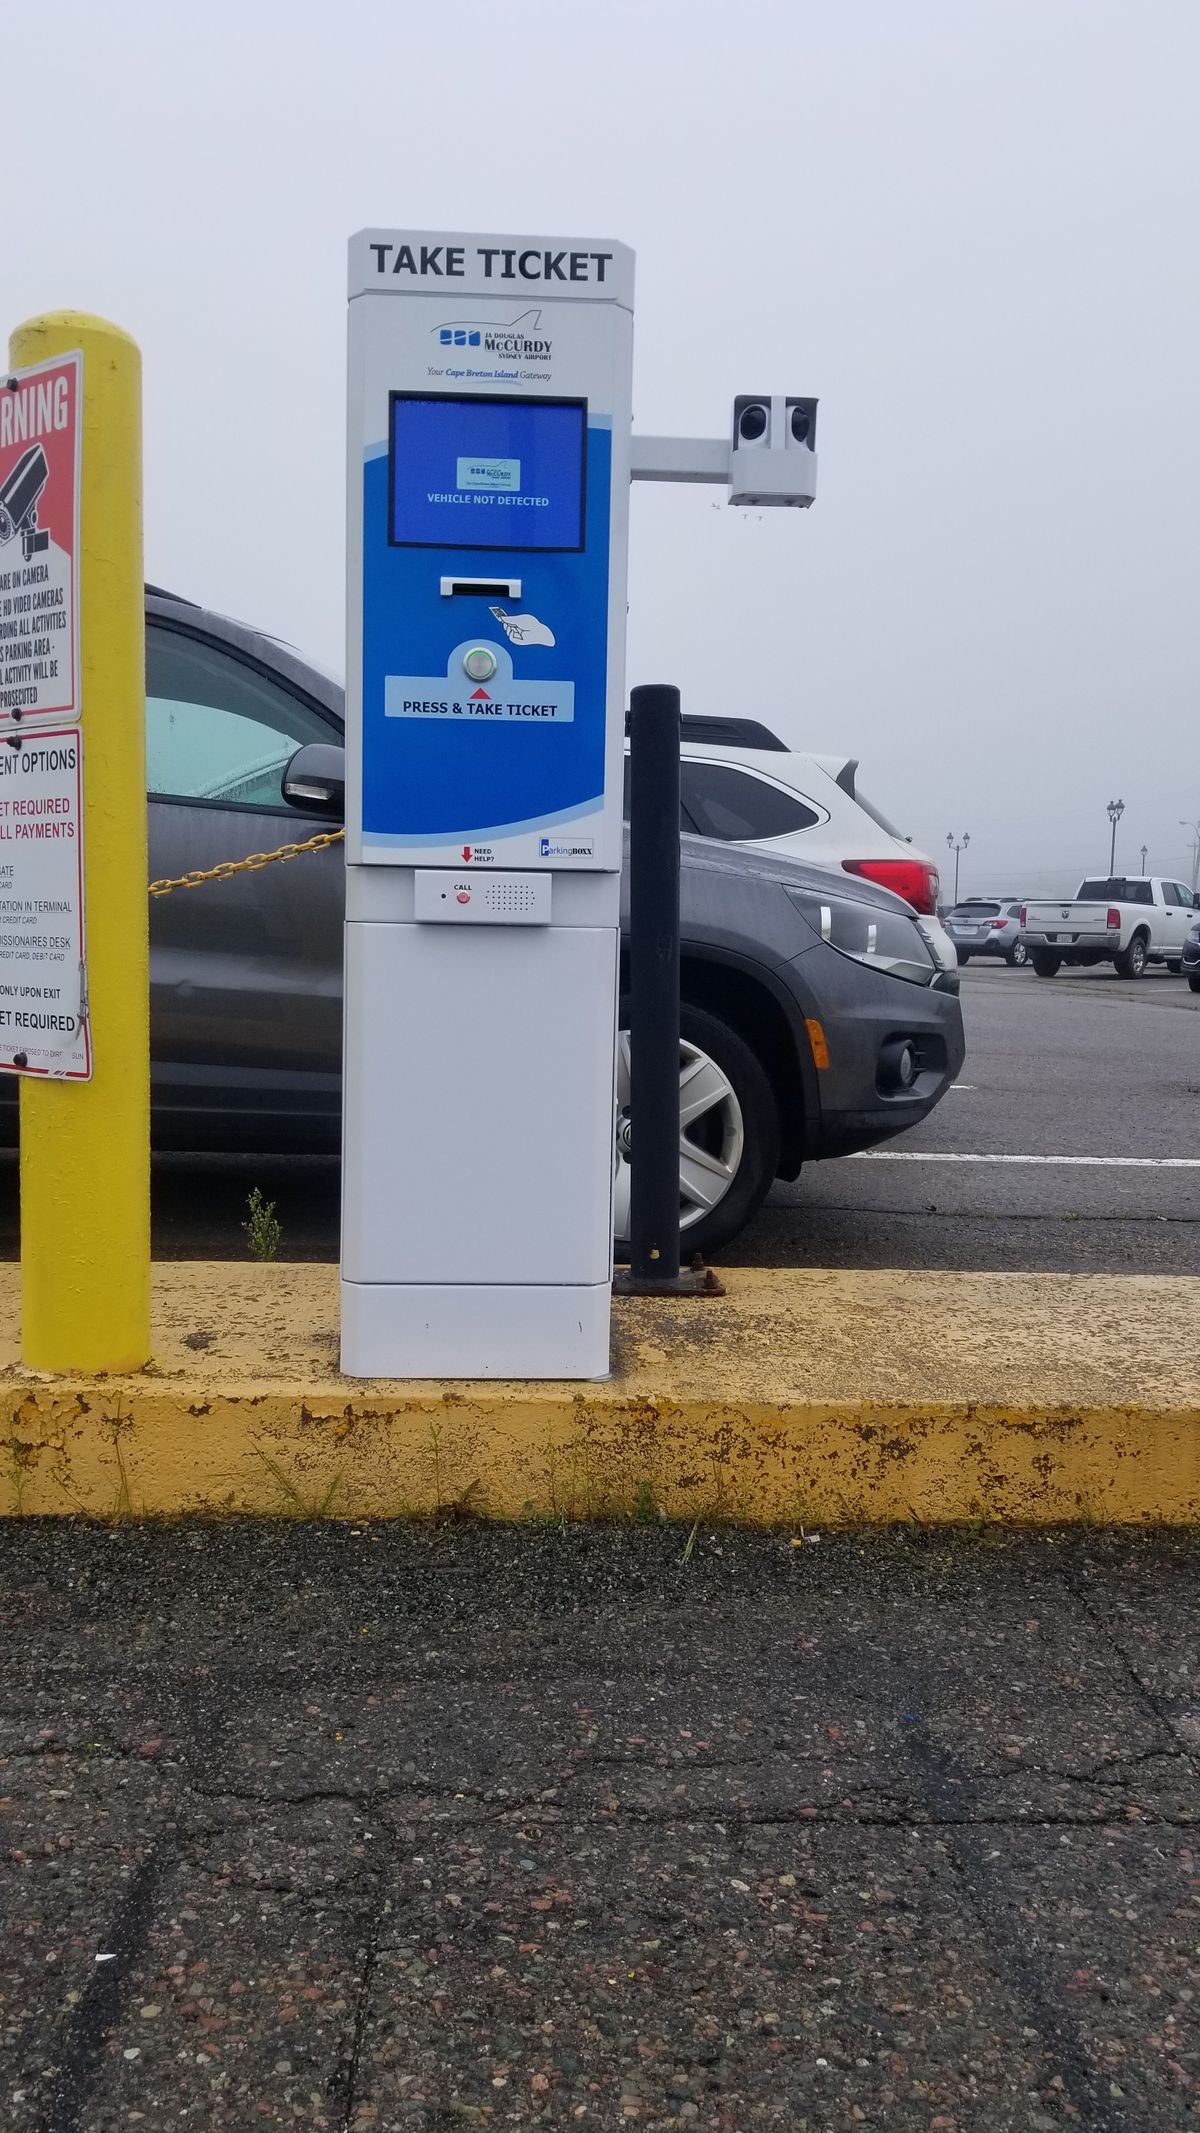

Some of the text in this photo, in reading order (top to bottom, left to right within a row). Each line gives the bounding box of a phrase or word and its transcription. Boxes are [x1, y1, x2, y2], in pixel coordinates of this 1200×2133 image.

[369, 243, 613, 282] TAKE TICKET
[484, 339, 552, 352] McCURDY
[427, 366, 551, 380] Your Cape Breton Island Gateway
[1, 376, 68, 448] RNING
[427, 493, 550, 506] VEHICLE NOT DETECTED
[12, 570, 21, 589] ON
[22, 564, 49, 586] CAMERA
[13, 594, 31, 614] VIDEO
[32, 587, 64, 610] CAMERAS
[19, 617, 30, 636] ALL
[31, 610, 67, 634] ACTIVITIES
[5, 640, 32, 661] PARKING
[33, 637, 51, 656] AREA
[5, 663, 31, 684] ACTIVITY
[33, 660, 49, 680] WILL
[50, 659, 58, 677] BE
[0, 686, 38, 708] PROSECUTED
[403, 701, 557, 717] PRESS & TAKE TICKET
[22, 748, 76, 773] OPTIONS
[13, 798, 70, 816] REQUIRED
[15, 822, 74, 840] PAYMENTS
[0, 865, 14, 877] ATE
[25, 901, 32, 912] IN
[34, 901, 72, 913] TERMINAL
[3, 916, 21, 924] CREDIT
[22, 916, 38, 925] CARD
[49, 936, 71, 948] DESK
[32, 952, 48, 961] DEBIT
[49, 953, 65, 962] CARD
[0, 985, 61, 999] ONLY UPON EXIT
[15, 1012, 75, 1032] REQUIRED
